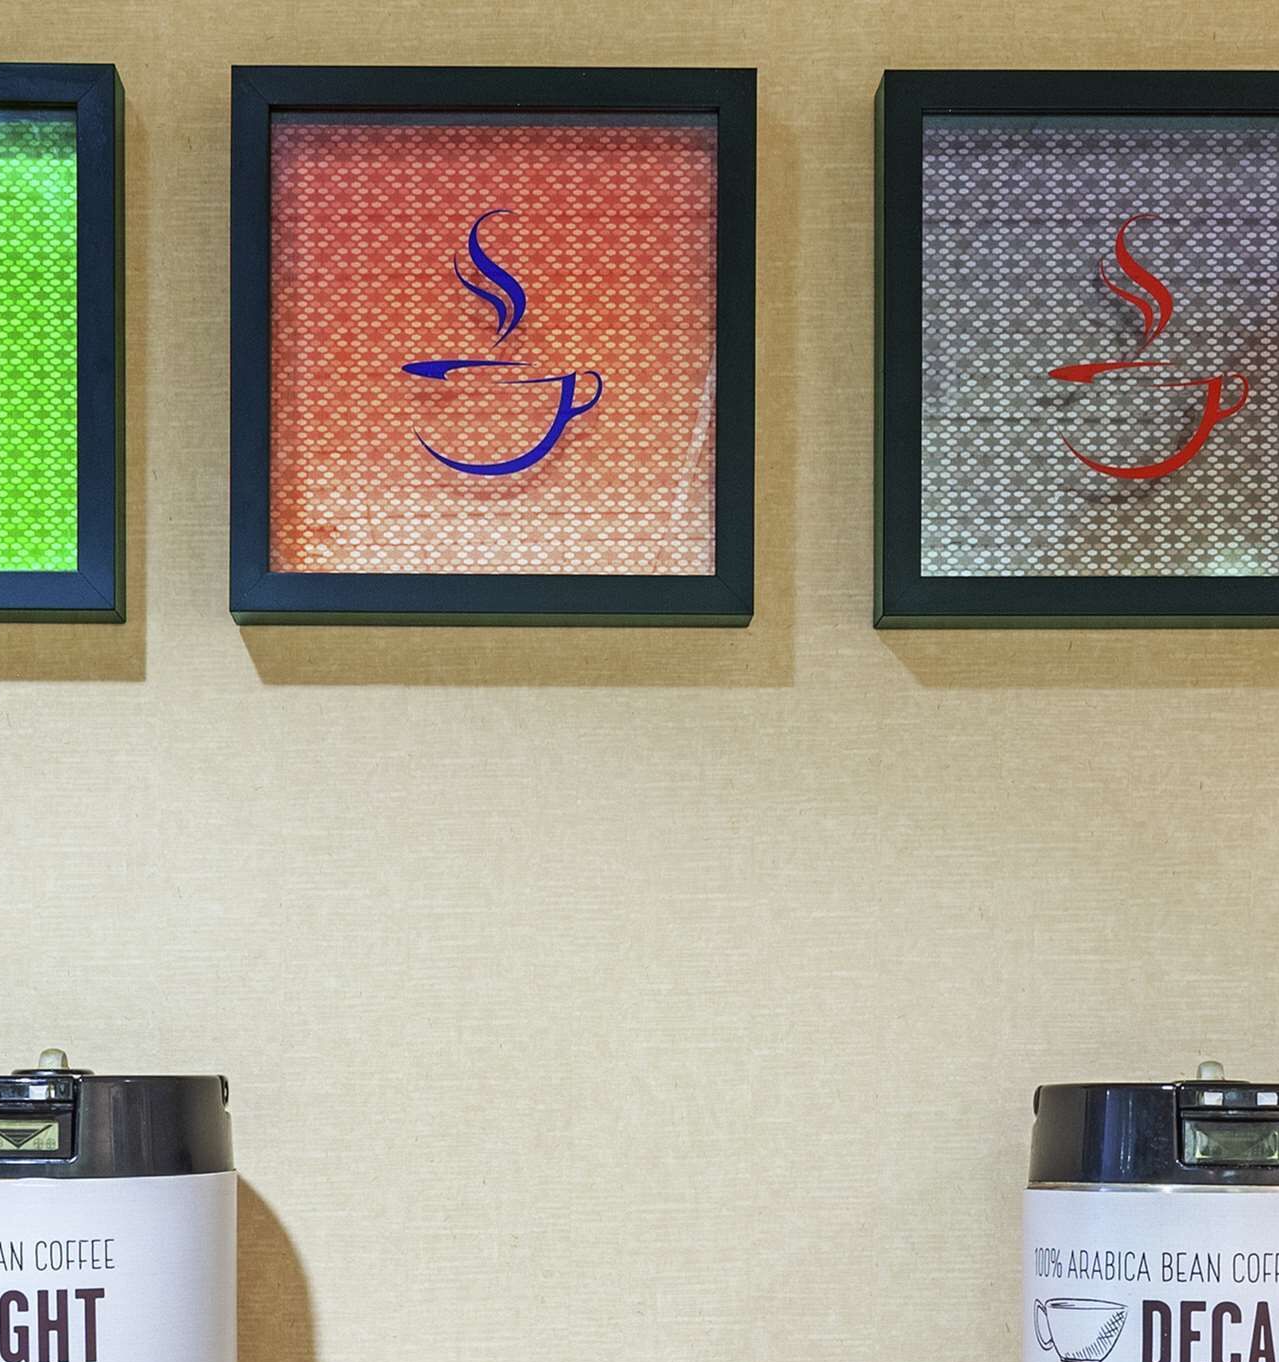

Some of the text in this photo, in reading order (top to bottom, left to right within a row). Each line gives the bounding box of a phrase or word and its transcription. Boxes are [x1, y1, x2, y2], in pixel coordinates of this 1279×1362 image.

[35, 1239, 116, 1271] COFFEE
[1035, 1247, 1062, 1278] 100%
[1068, 1250, 1151, 1282] ARABICA
[1161, 1252, 1221, 1283] BEAN
